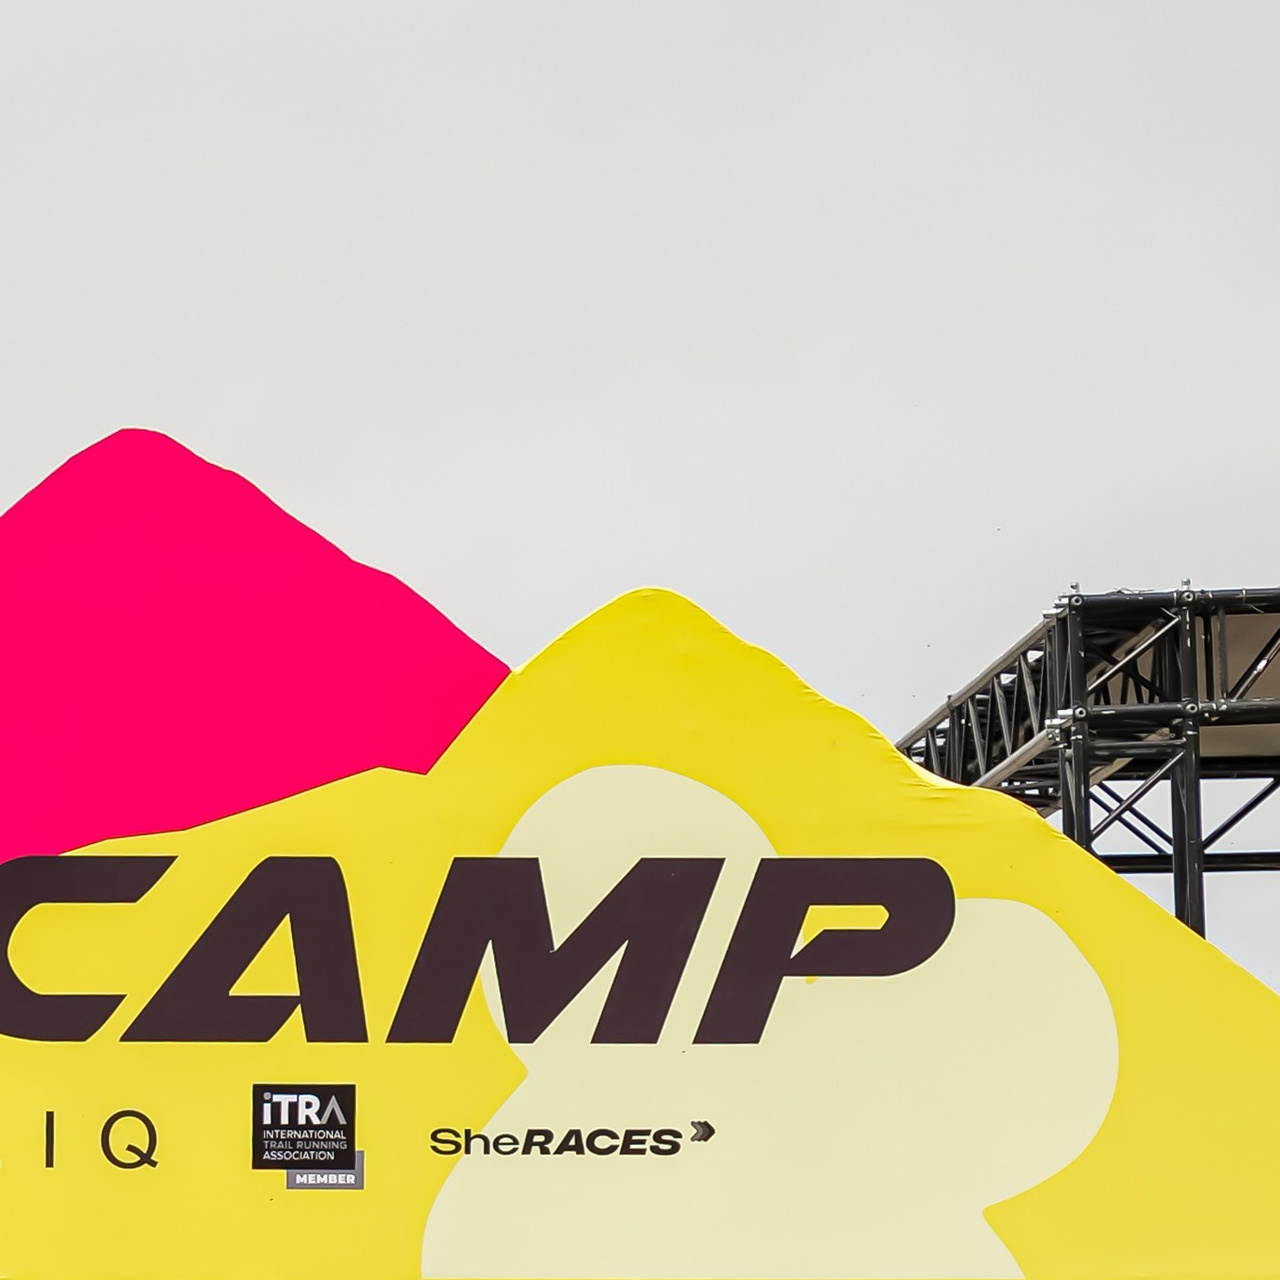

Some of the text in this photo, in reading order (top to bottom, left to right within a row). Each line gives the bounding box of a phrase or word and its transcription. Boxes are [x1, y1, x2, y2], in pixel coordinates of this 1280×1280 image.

[262, 1129, 347, 1140] INTERNATIONAL
[262, 1140, 348, 1151] TRAIL RUNNING
[429, 1127, 684, 1156] SheRACES
[262, 1150, 335, 1161] ASSOCIATION
[295, 1173, 356, 1185] MEMBER
